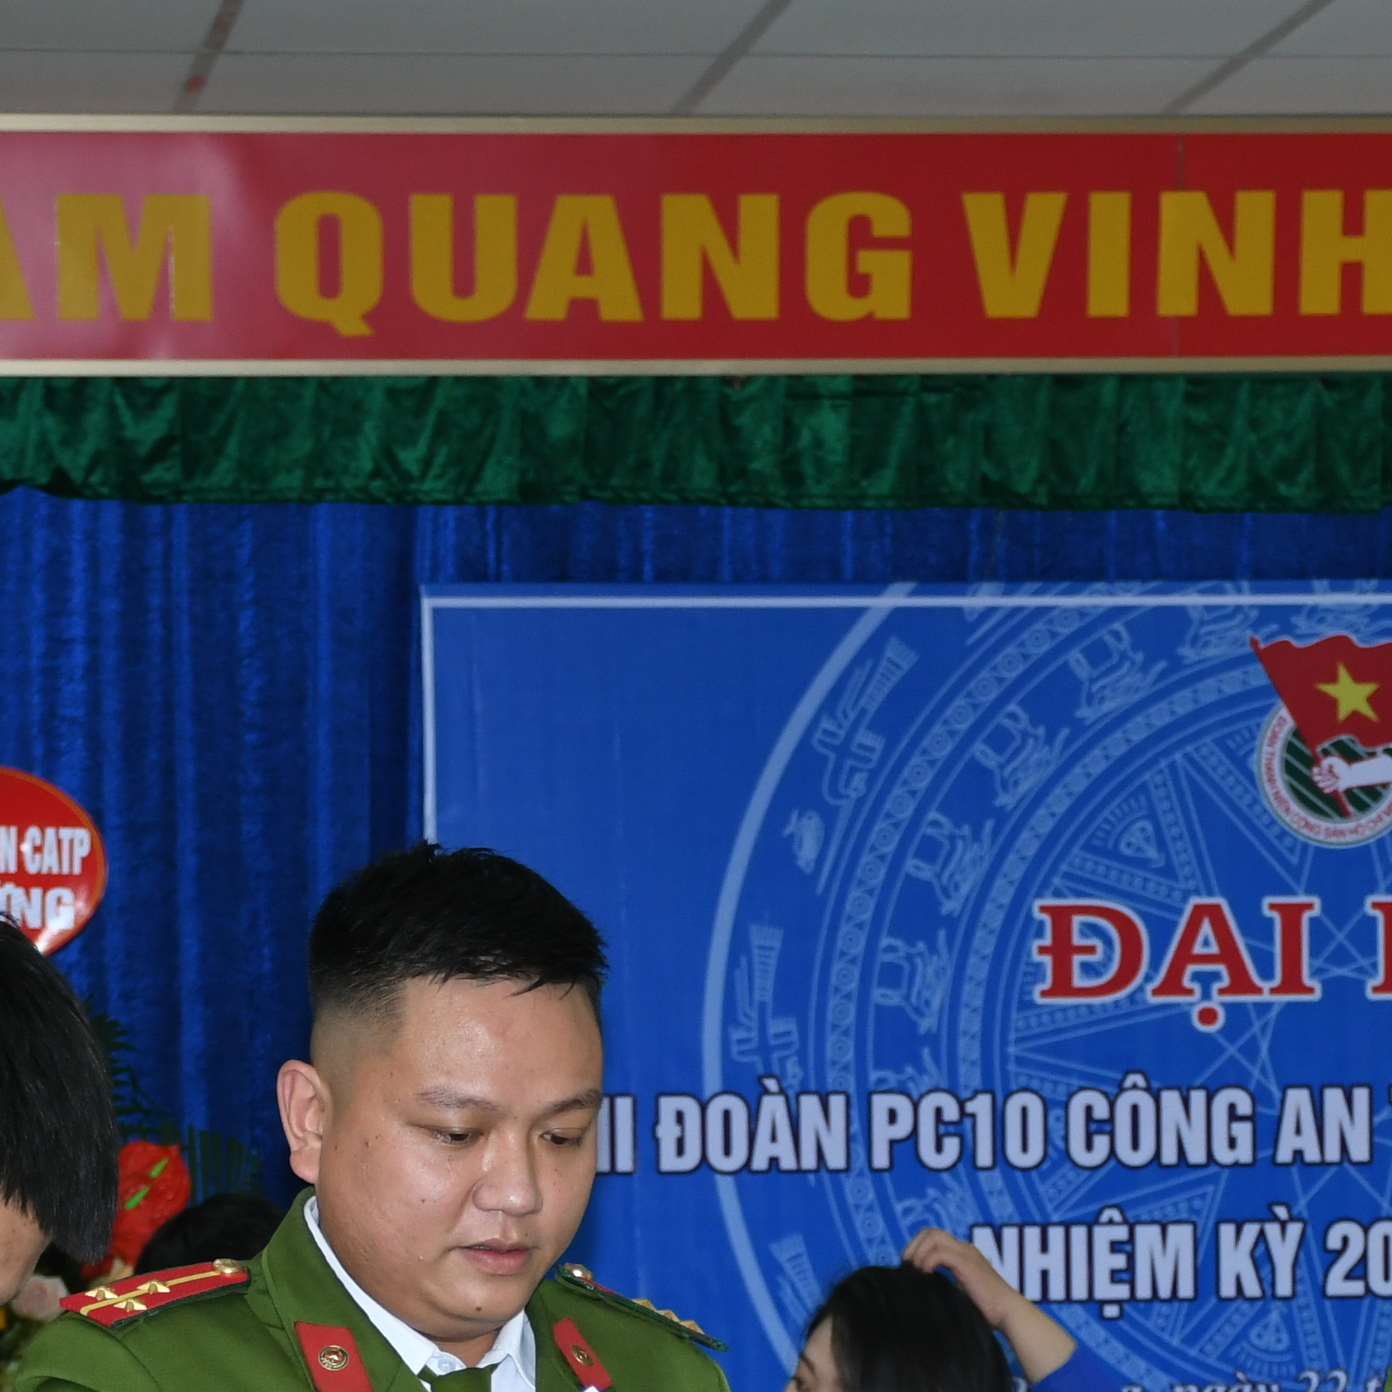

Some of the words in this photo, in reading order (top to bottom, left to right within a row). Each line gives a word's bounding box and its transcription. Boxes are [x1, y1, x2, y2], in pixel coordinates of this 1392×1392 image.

[274, 189, 913, 338] QUANG
[21, 826, 92, 875] CATP
[1034, 894, 1321, 1031] ĐẠI
[655, 1076, 850, 1174] ĐOÀN
[869, 1088, 1048, 1172] PC10
[1065, 1072, 1257, 1168] CÔNG
[1273, 1086, 1374, 1165] AN
[970, 1205, 1198, 1320] NHIỆM
[1218, 1204, 1305, 1300] KỲ
